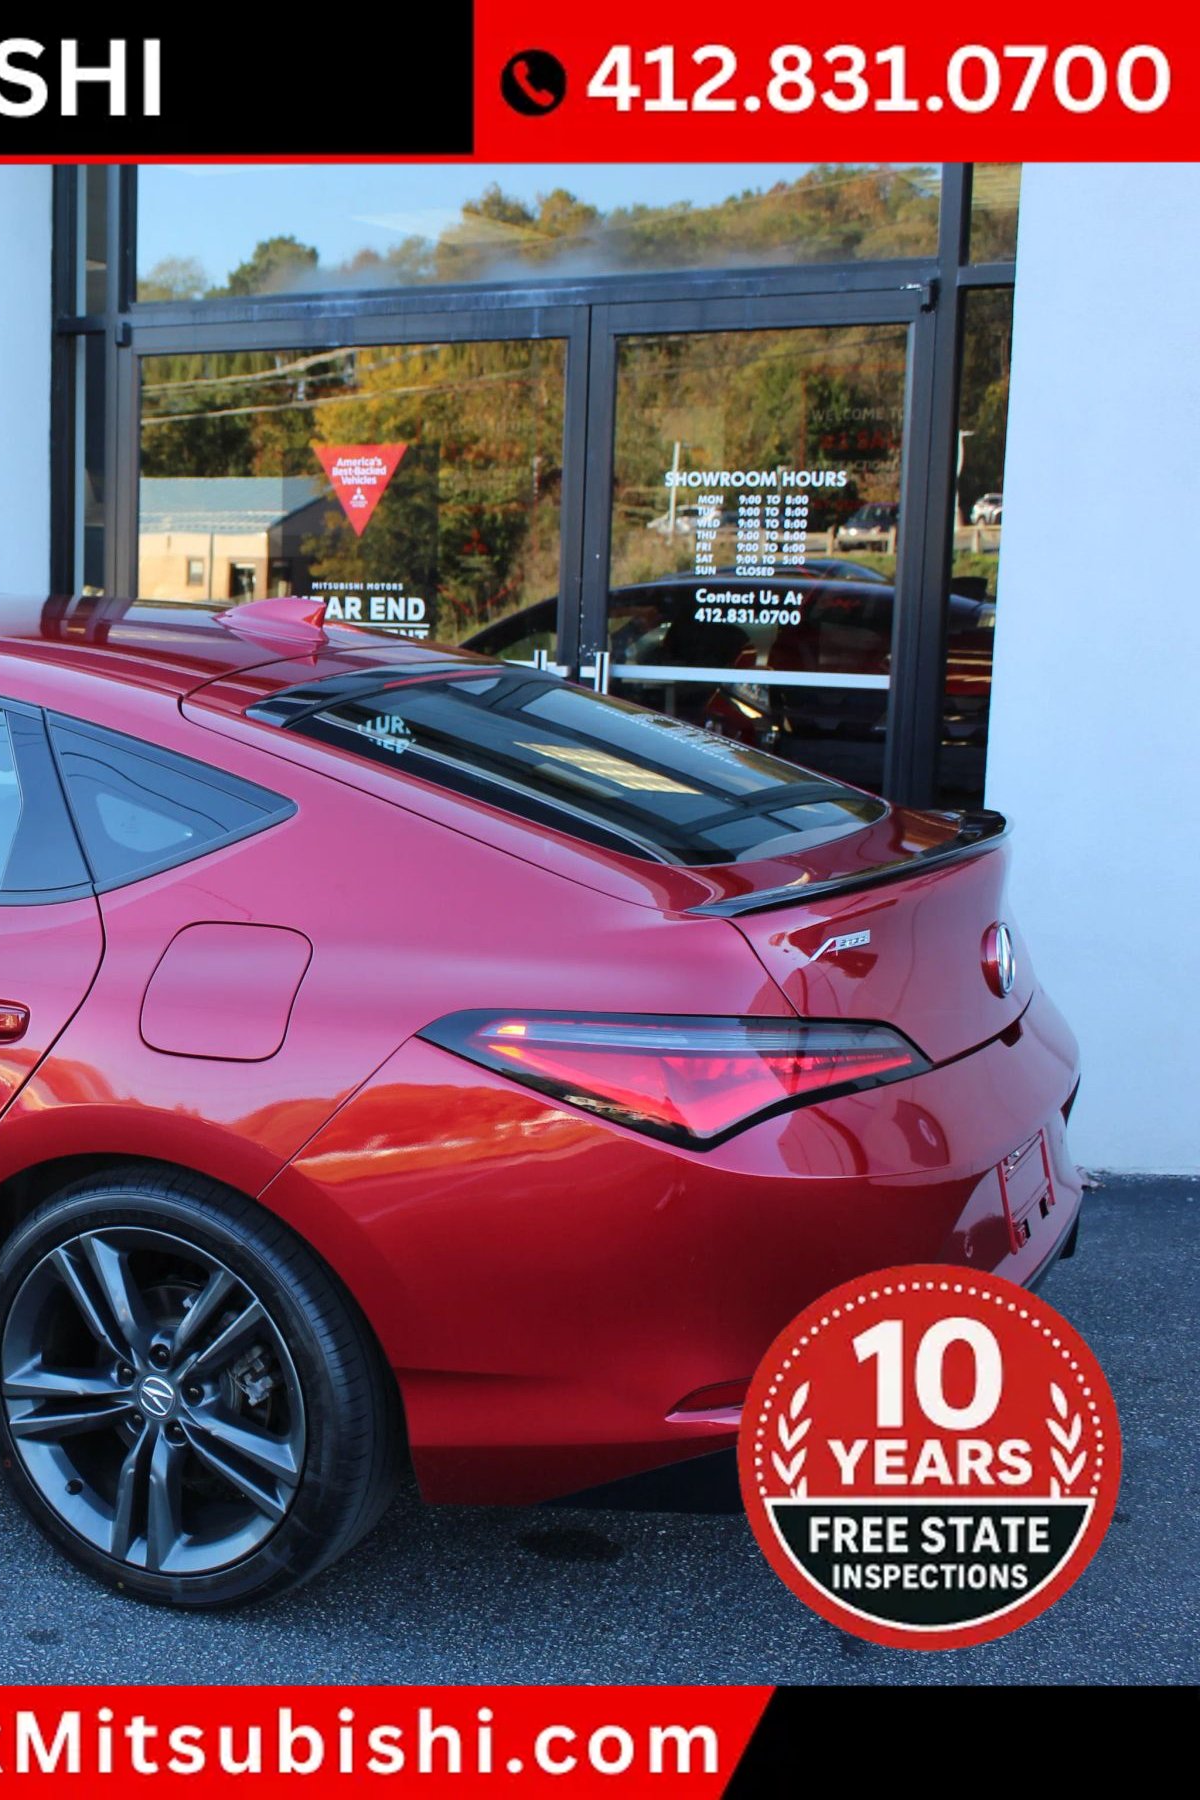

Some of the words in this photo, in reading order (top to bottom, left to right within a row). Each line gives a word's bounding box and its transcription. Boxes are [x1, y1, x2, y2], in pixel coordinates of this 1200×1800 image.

[336, 456, 383, 467] America's
[332, 466, 387, 477] Best-Backed
[341, 475, 377, 486] Vehicles
[665, 470, 778, 488] SHOWROOM
[782, 470, 848, 488] HOURS
[698, 495, 724, 505] MON
[738, 495, 762, 505] 9:00
[766, 495, 781, 505] TO
[785, 495, 809, 505] 8:00
[738, 507, 761, 517] 9:00
[765, 507, 779, 517] TO
[784, 507, 808, 517] 8:00
[697, 519, 721, 528] WED
[738, 519, 760, 529] 9:00
[765, 519, 779, 529] TO
[784, 519, 808, 529] 8:00
[697, 531, 717, 540] THU
[737, 531, 760, 541] 9:00
[765, 531, 779, 541] TO
[783, 531, 807, 541] 8:00
[696, 542, 712, 552] FRI
[737, 543, 759, 553] 9:00
[763, 543, 778, 553] TO
[782, 543, 806, 553] 6:00
[695, 554, 713, 564] SAT
[736, 555, 758, 565] 9:00
[762, 555, 776, 565] TO
[695, 566, 717, 576] SUN
[736, 566, 775, 576] CLOSED
[312, 582, 364, 591] MITSUBISHI
[366, 583, 404, 591] MOTORS
[695, 588, 755, 604] Contact
[759, 589, 780, 605] Us
[783, 590, 804, 606] At
[369, 597, 426, 621] END
[694, 607, 802, 625] 412.831.0700
